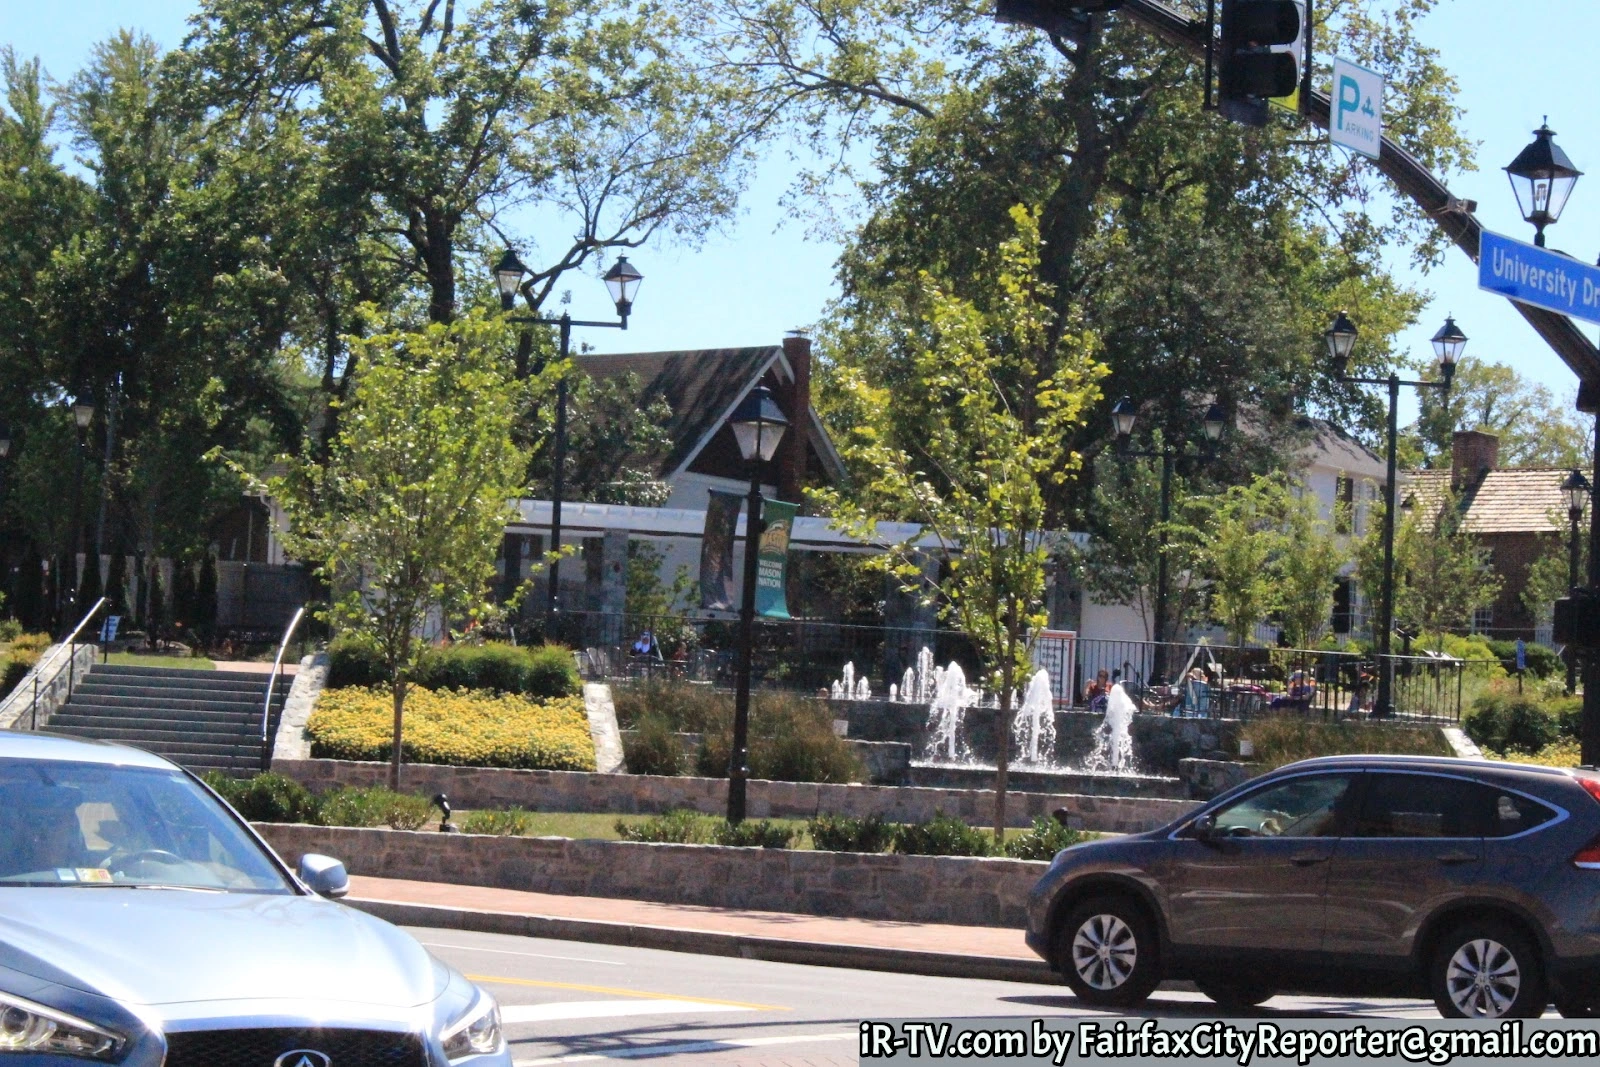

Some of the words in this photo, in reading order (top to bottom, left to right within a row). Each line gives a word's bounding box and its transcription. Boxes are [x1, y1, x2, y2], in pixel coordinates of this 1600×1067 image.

[1492, 246, 1577, 307] University
[1583, 277, 1600, 308] Dr
[759, 559, 783, 570] WELCOME
[758, 567, 782, 579] MASON
[758, 577, 781, 589] NATION
